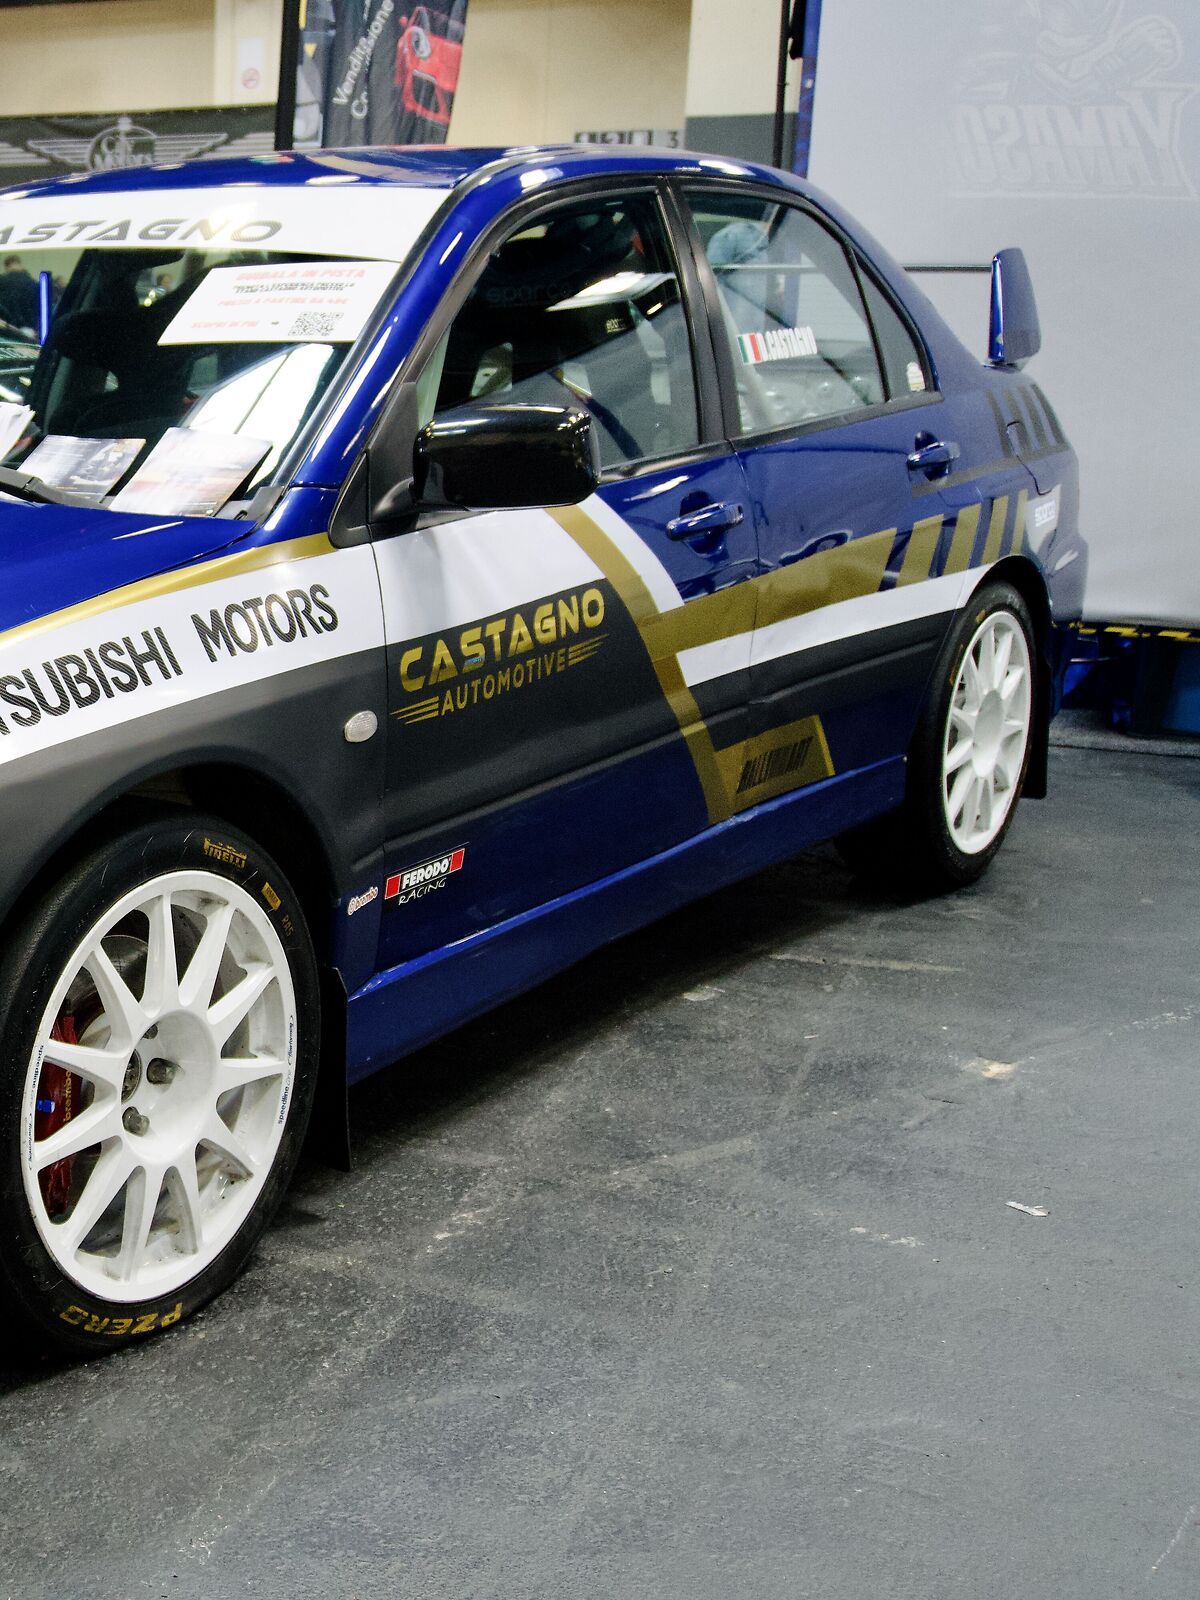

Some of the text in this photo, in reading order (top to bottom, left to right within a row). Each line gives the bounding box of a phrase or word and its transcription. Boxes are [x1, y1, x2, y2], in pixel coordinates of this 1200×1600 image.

[190, 583, 339, 663] MOTORS
[400, 588, 605, 693] CASTAGNO
[441, 648, 567, 716] AUTOMOTIVE
[398, 878, 447, 906] RACING
[401, 857, 450, 890] FERODO
